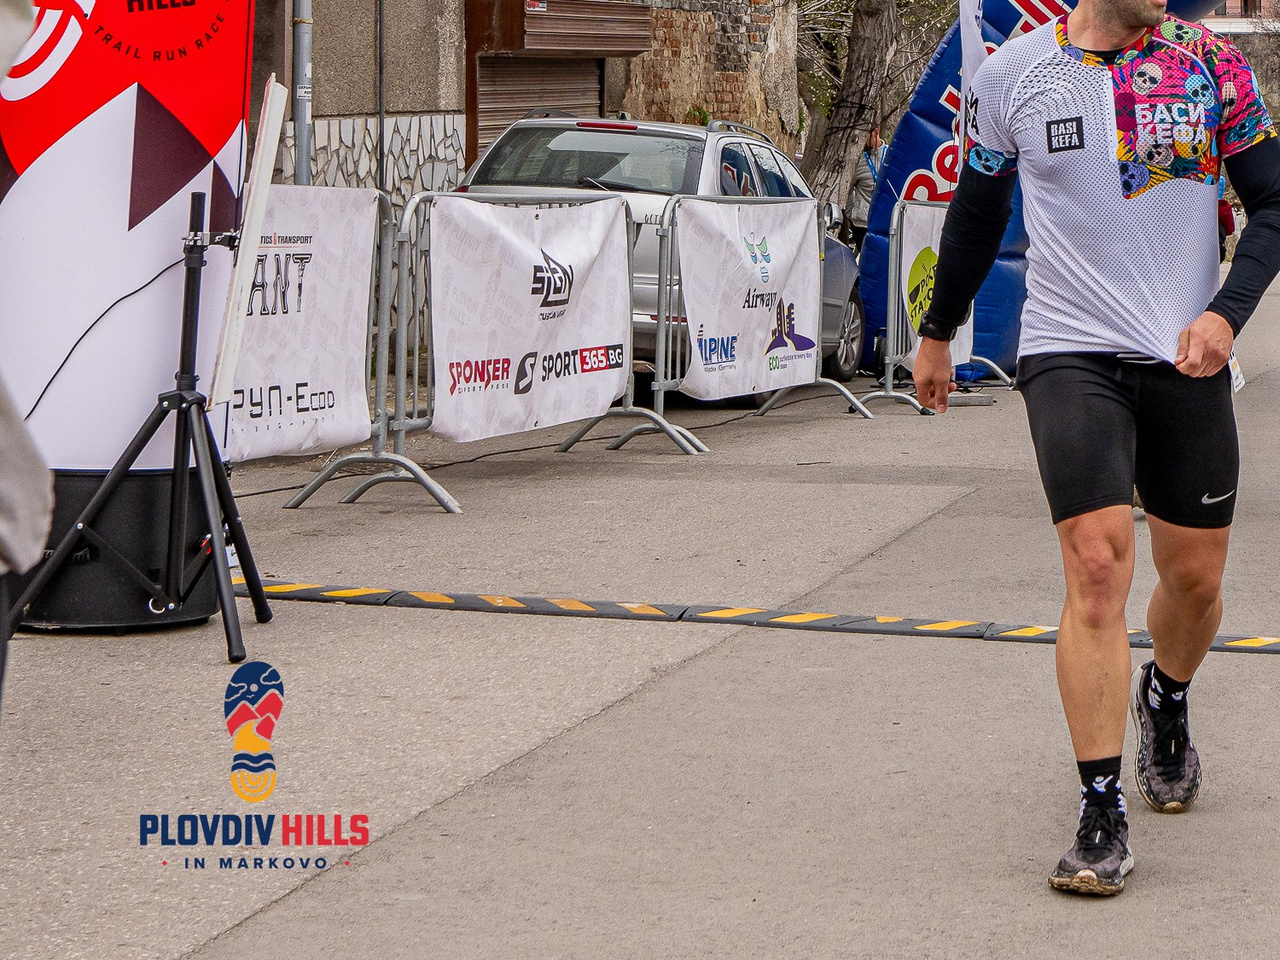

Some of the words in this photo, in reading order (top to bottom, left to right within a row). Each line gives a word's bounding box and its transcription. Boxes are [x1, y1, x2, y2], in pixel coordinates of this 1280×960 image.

[93, 25, 142, 60] TRAIL
[153, 46, 188, 62] RUN
[194, 13, 225, 51] RACE
[1135, 102, 1207, 125] БАСИ
[1050, 121, 1077, 137] BASI
[1136, 123, 1208, 145] КЕФА
[1051, 134, 1080, 149] KEFA
[449, 358, 511, 396] SPONSER
